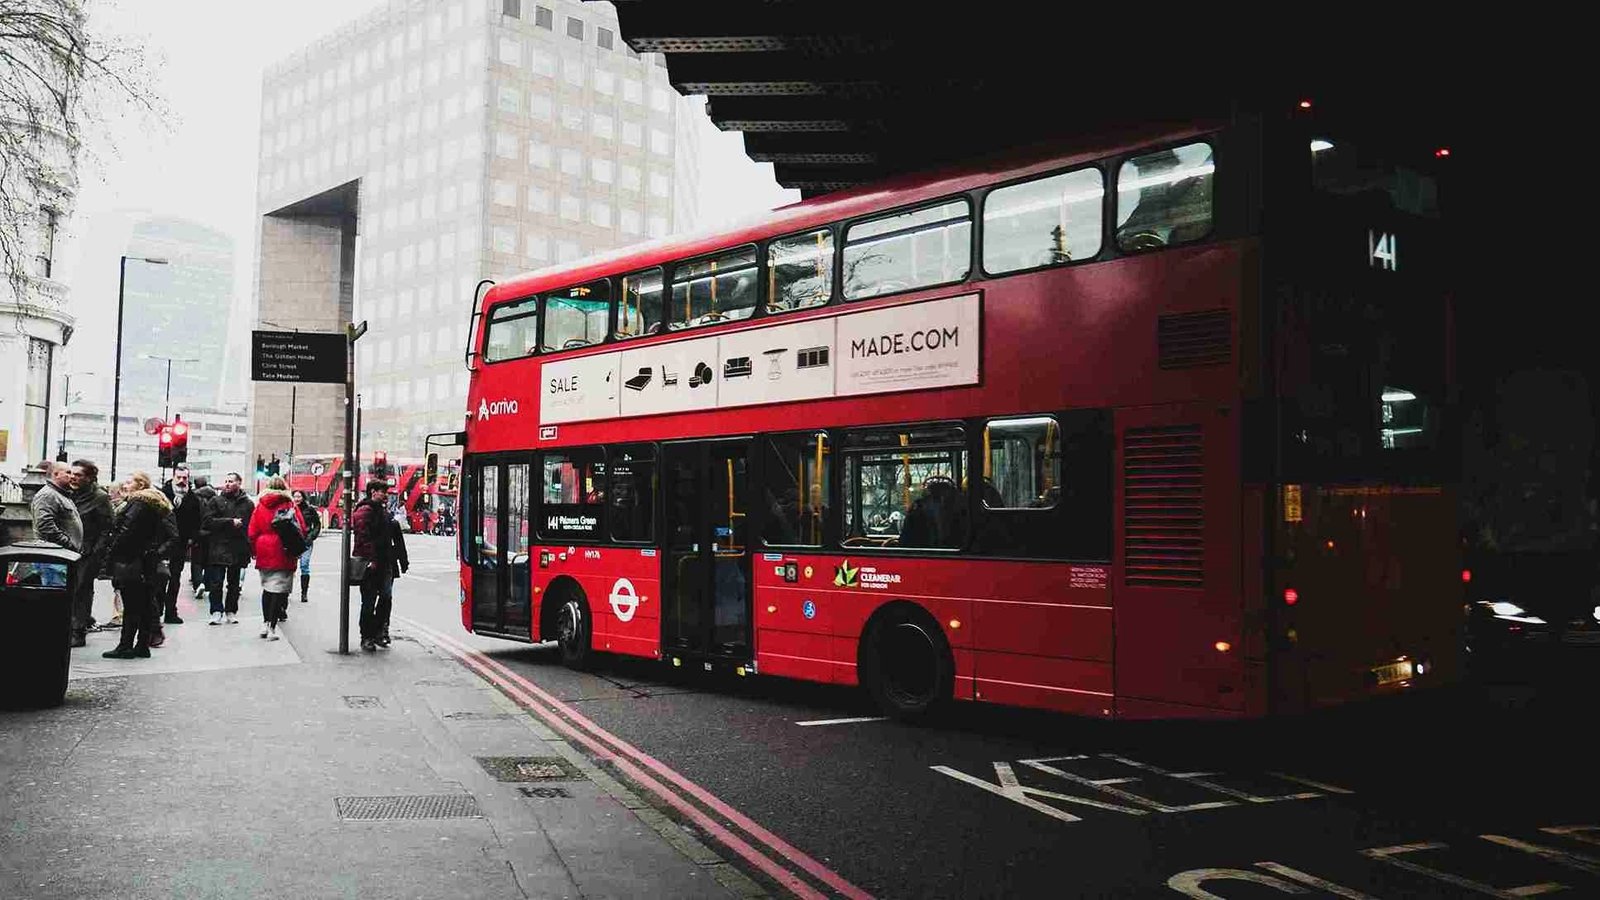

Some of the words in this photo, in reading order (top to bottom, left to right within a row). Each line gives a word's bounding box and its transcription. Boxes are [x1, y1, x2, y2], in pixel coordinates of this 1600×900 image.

[1369, 229, 1396, 271] 141
[550, 376, 578, 394] SALE
[489, 398, 518, 415] arriva
[548, 516, 559, 530] 141
[580, 516, 597, 525] Green
